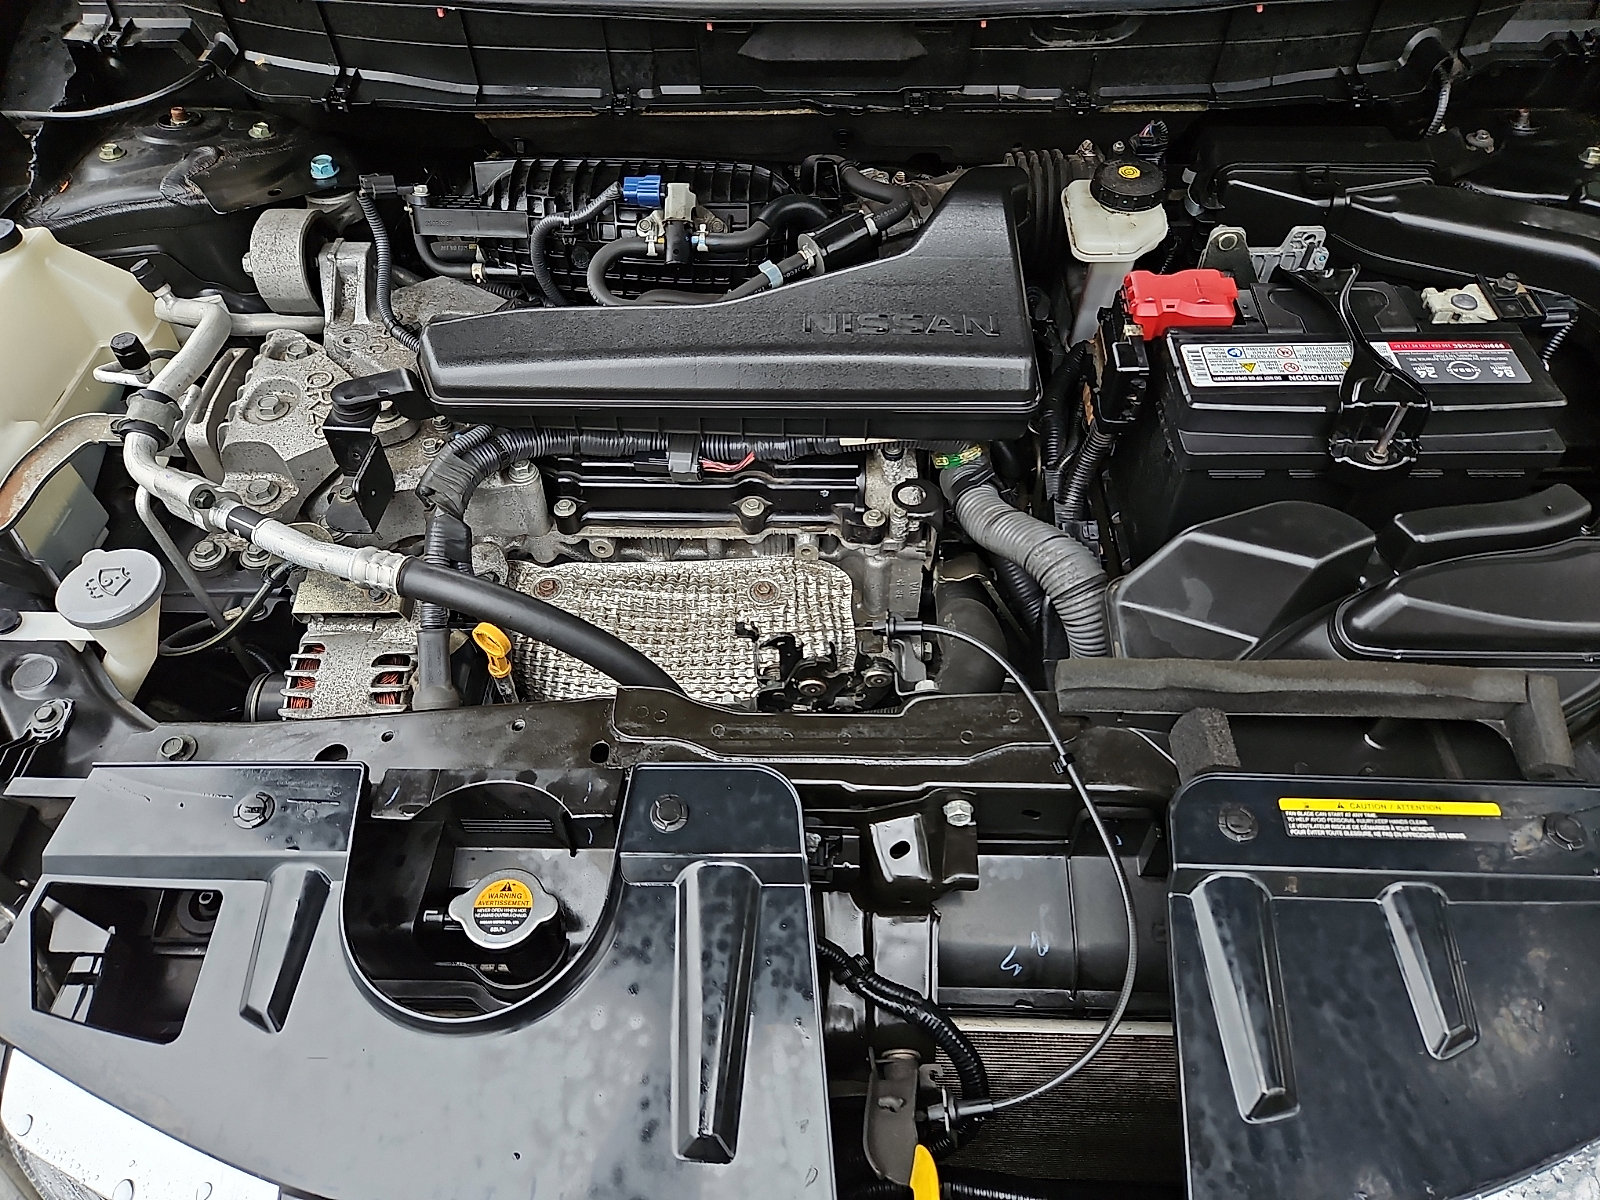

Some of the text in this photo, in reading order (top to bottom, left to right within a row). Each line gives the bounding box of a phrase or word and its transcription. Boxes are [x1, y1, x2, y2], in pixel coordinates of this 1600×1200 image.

[802, 313, 999, 336] NISSAN
[1416, 368, 1438, 379] 24
[1493, 369, 1516, 378] 84
[1396, 803, 1442, 811] ATTENTION
